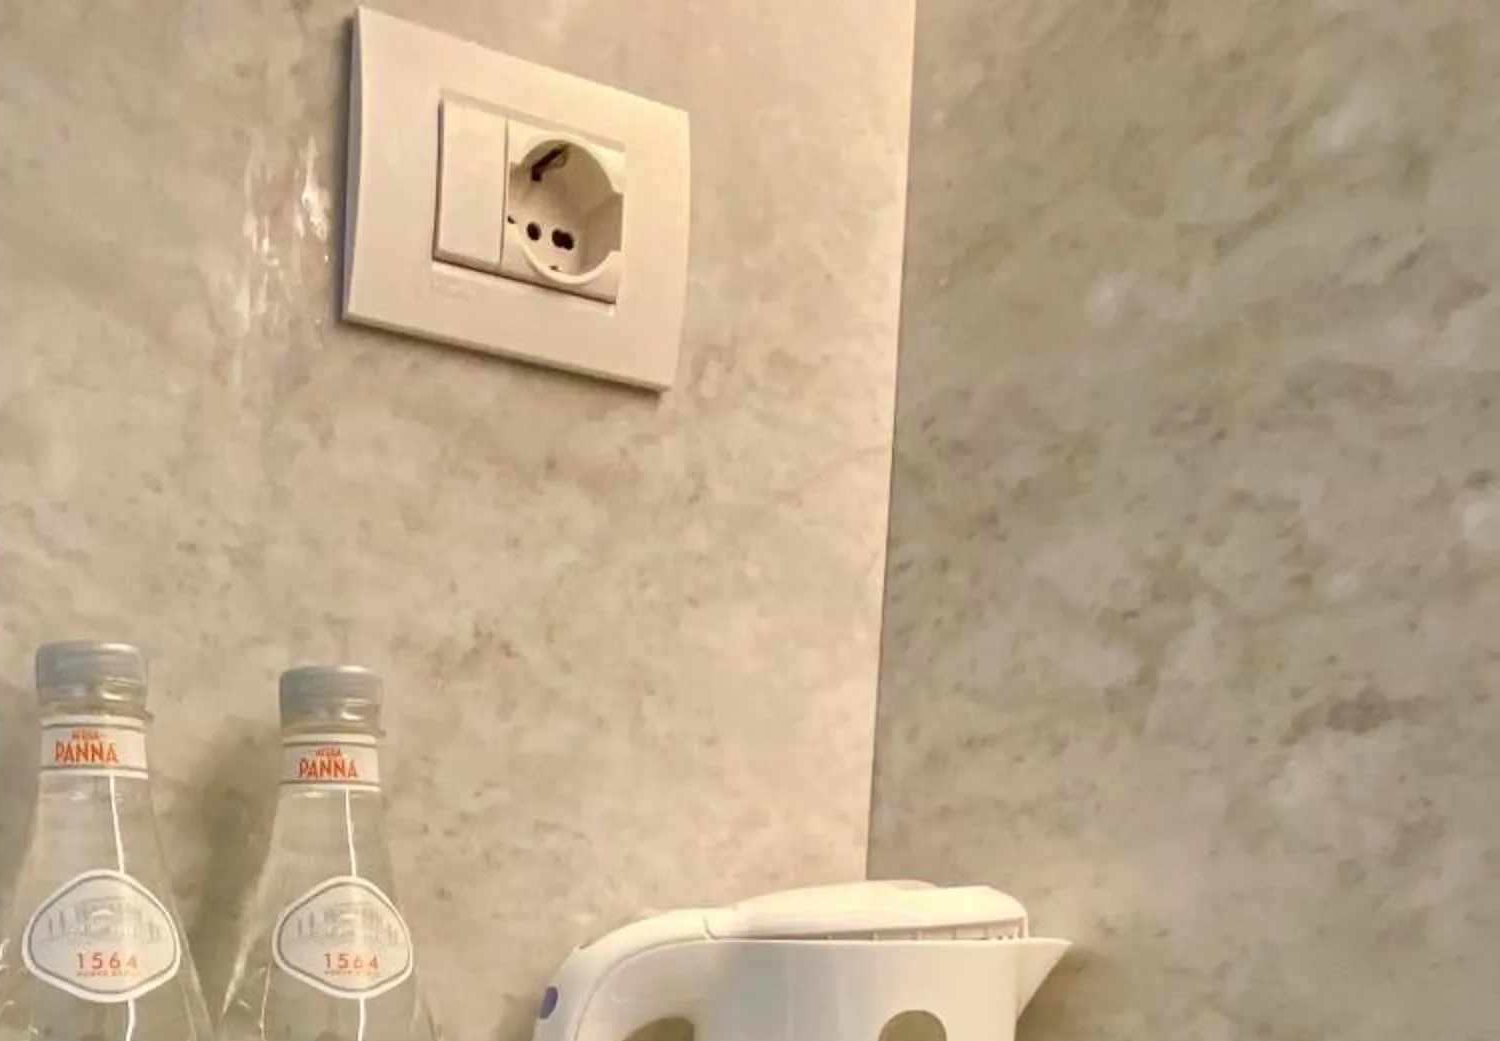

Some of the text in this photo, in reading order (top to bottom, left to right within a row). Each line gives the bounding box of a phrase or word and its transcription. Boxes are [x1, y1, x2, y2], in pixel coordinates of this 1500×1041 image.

[54, 740, 120, 764] PANNA
[298, 757, 358, 779] PANNA
[77, 951, 139, 970] 1564
[323, 952, 379, 970] 1564
